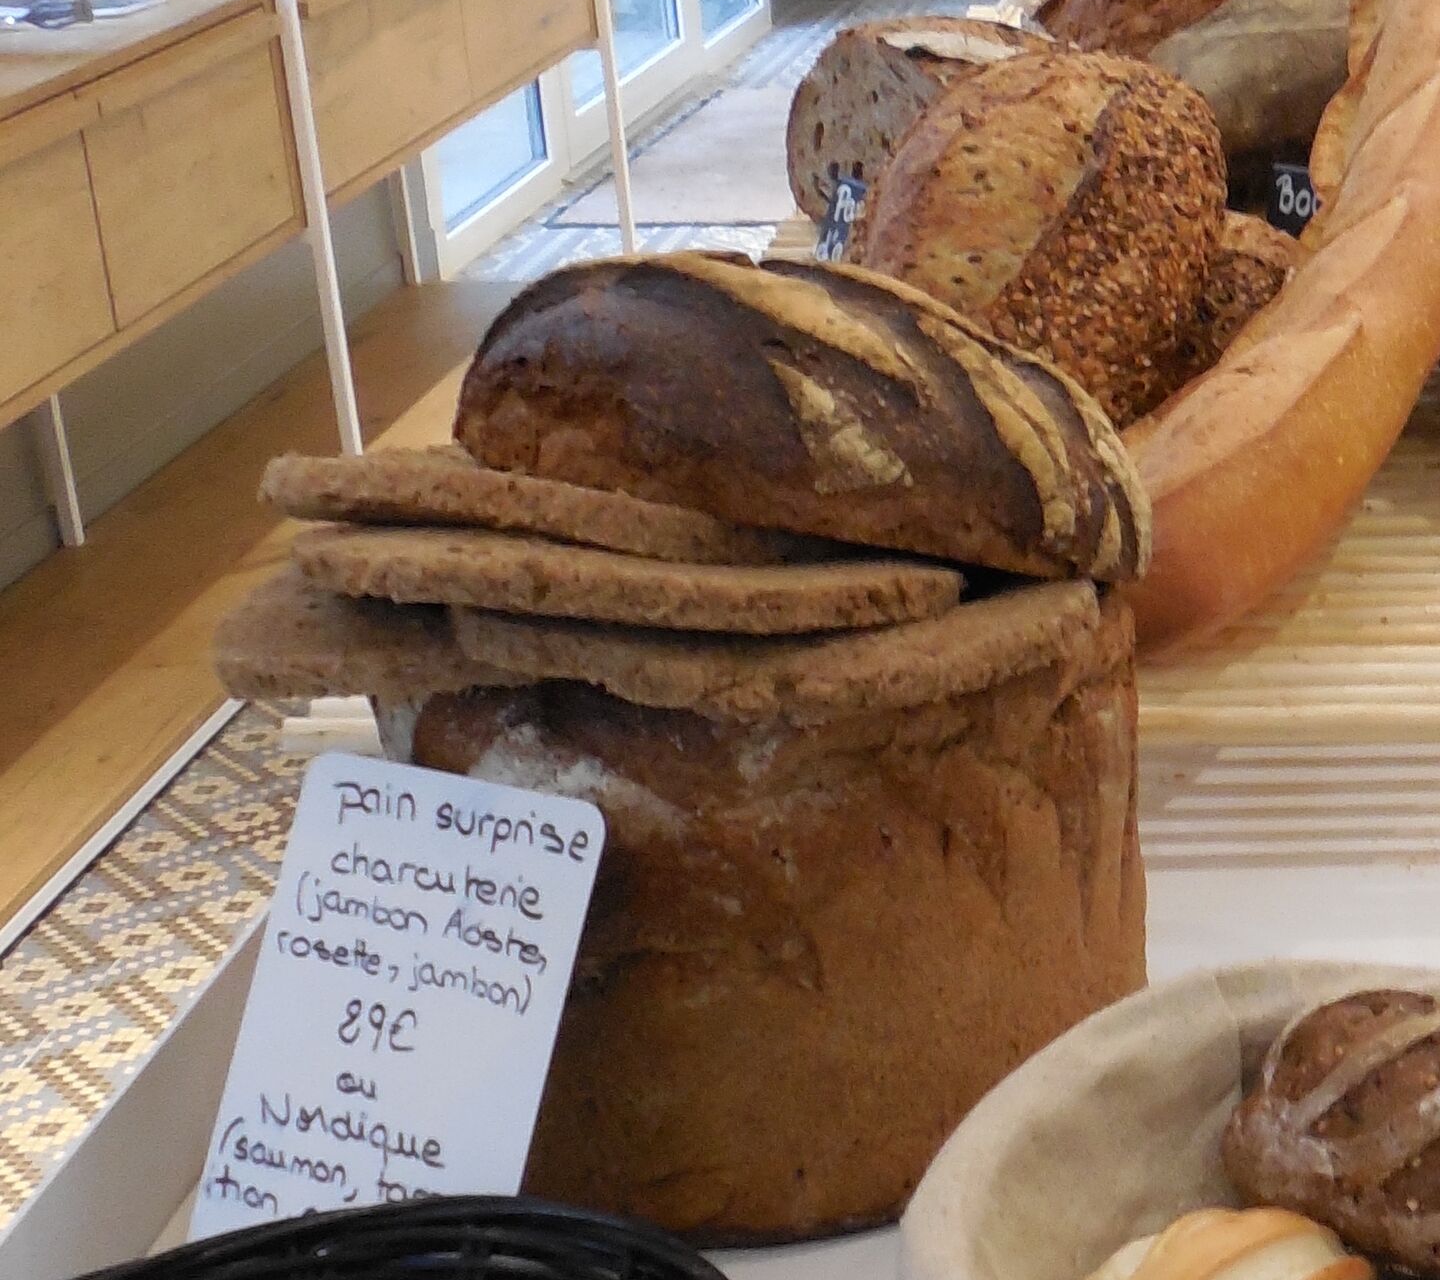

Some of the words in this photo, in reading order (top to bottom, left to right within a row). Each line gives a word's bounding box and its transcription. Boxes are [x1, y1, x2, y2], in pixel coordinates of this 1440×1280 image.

[436, 802, 588, 862] surprise
[297, 871, 427, 934] (jambon
[443, 908, 547, 975] Aoste,
[407, 953, 532, 1016] jambon)
[338, 999, 417, 1052] 89€
[336, 1072, 377, 1100] ou
[260, 1092, 444, 1172] Nordique
